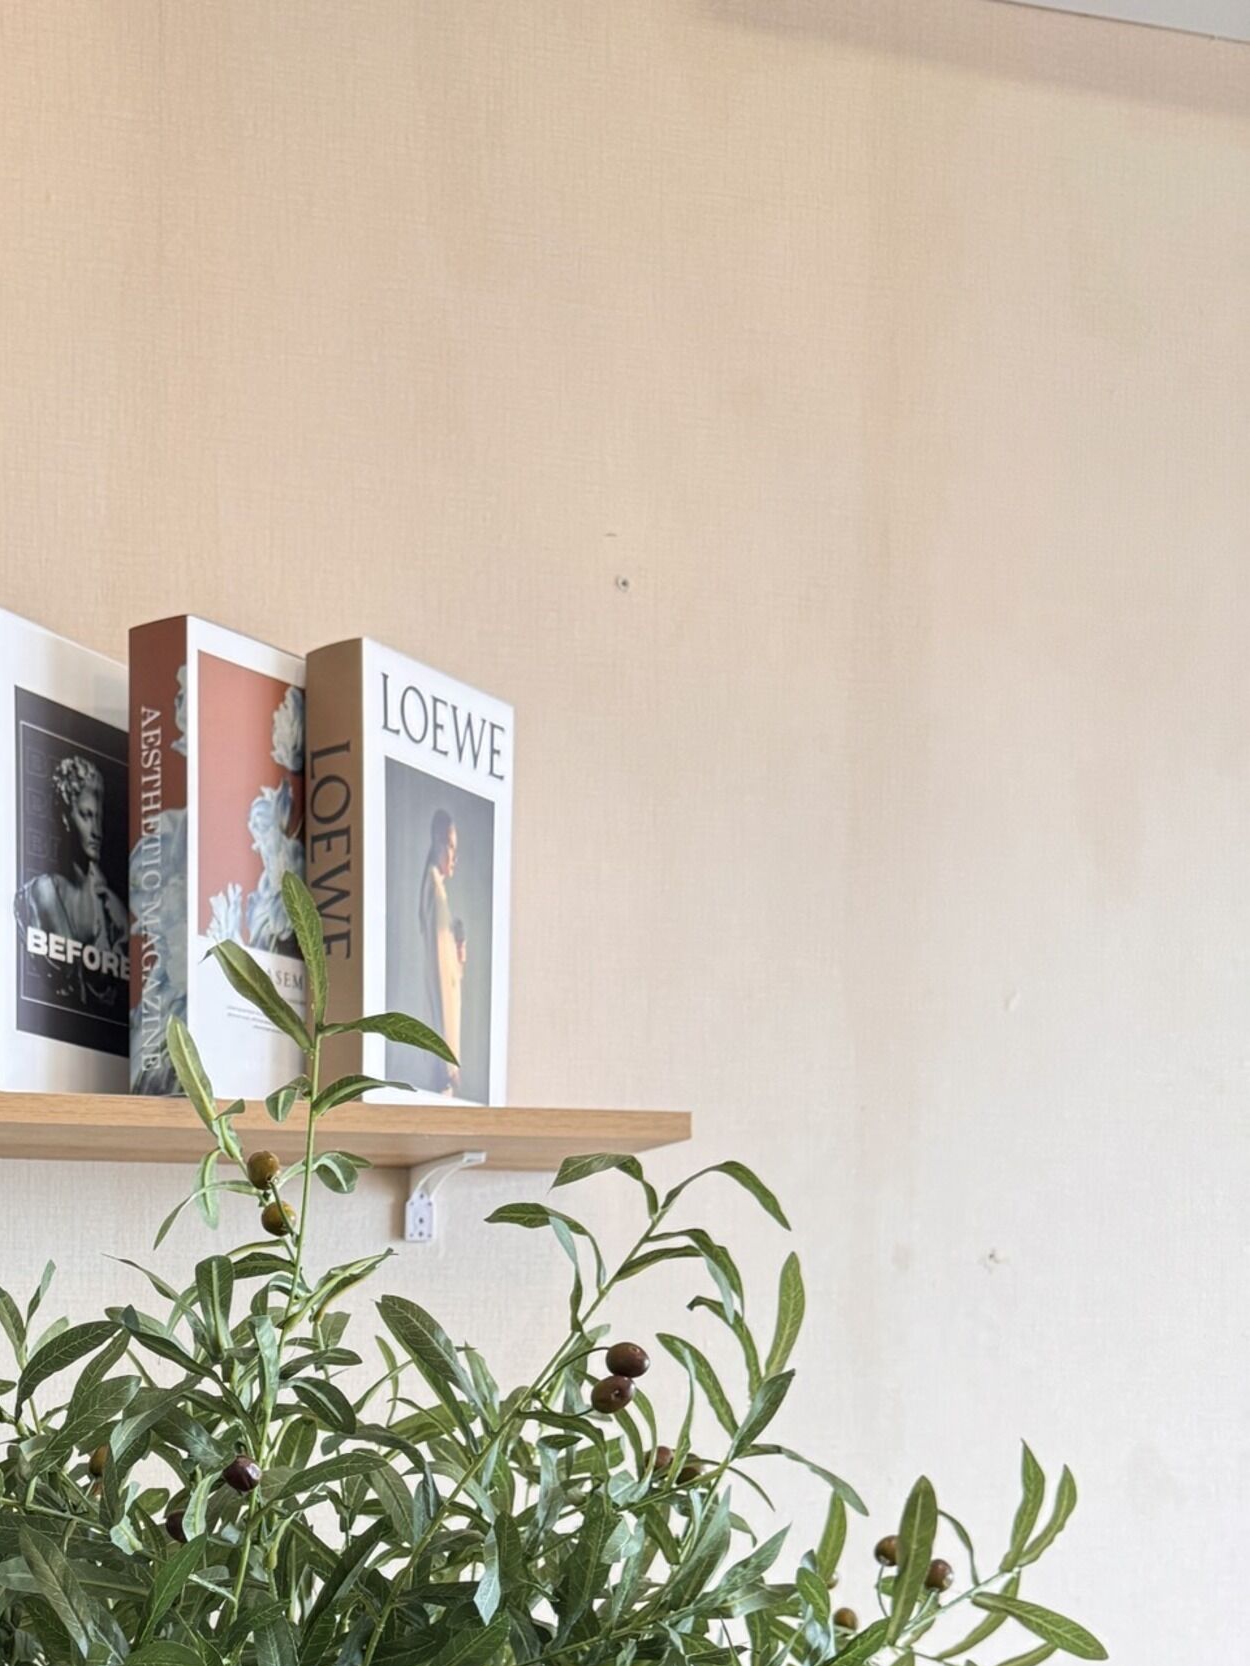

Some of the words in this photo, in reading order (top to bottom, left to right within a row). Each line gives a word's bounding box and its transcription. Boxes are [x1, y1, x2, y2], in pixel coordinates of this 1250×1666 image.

[139, 705, 163, 893] AESTHETIC
[379, 673, 506, 781] LOEWE
[308, 740, 352, 960] LOEWE
[140, 898, 163, 1073] MAGAZINE
